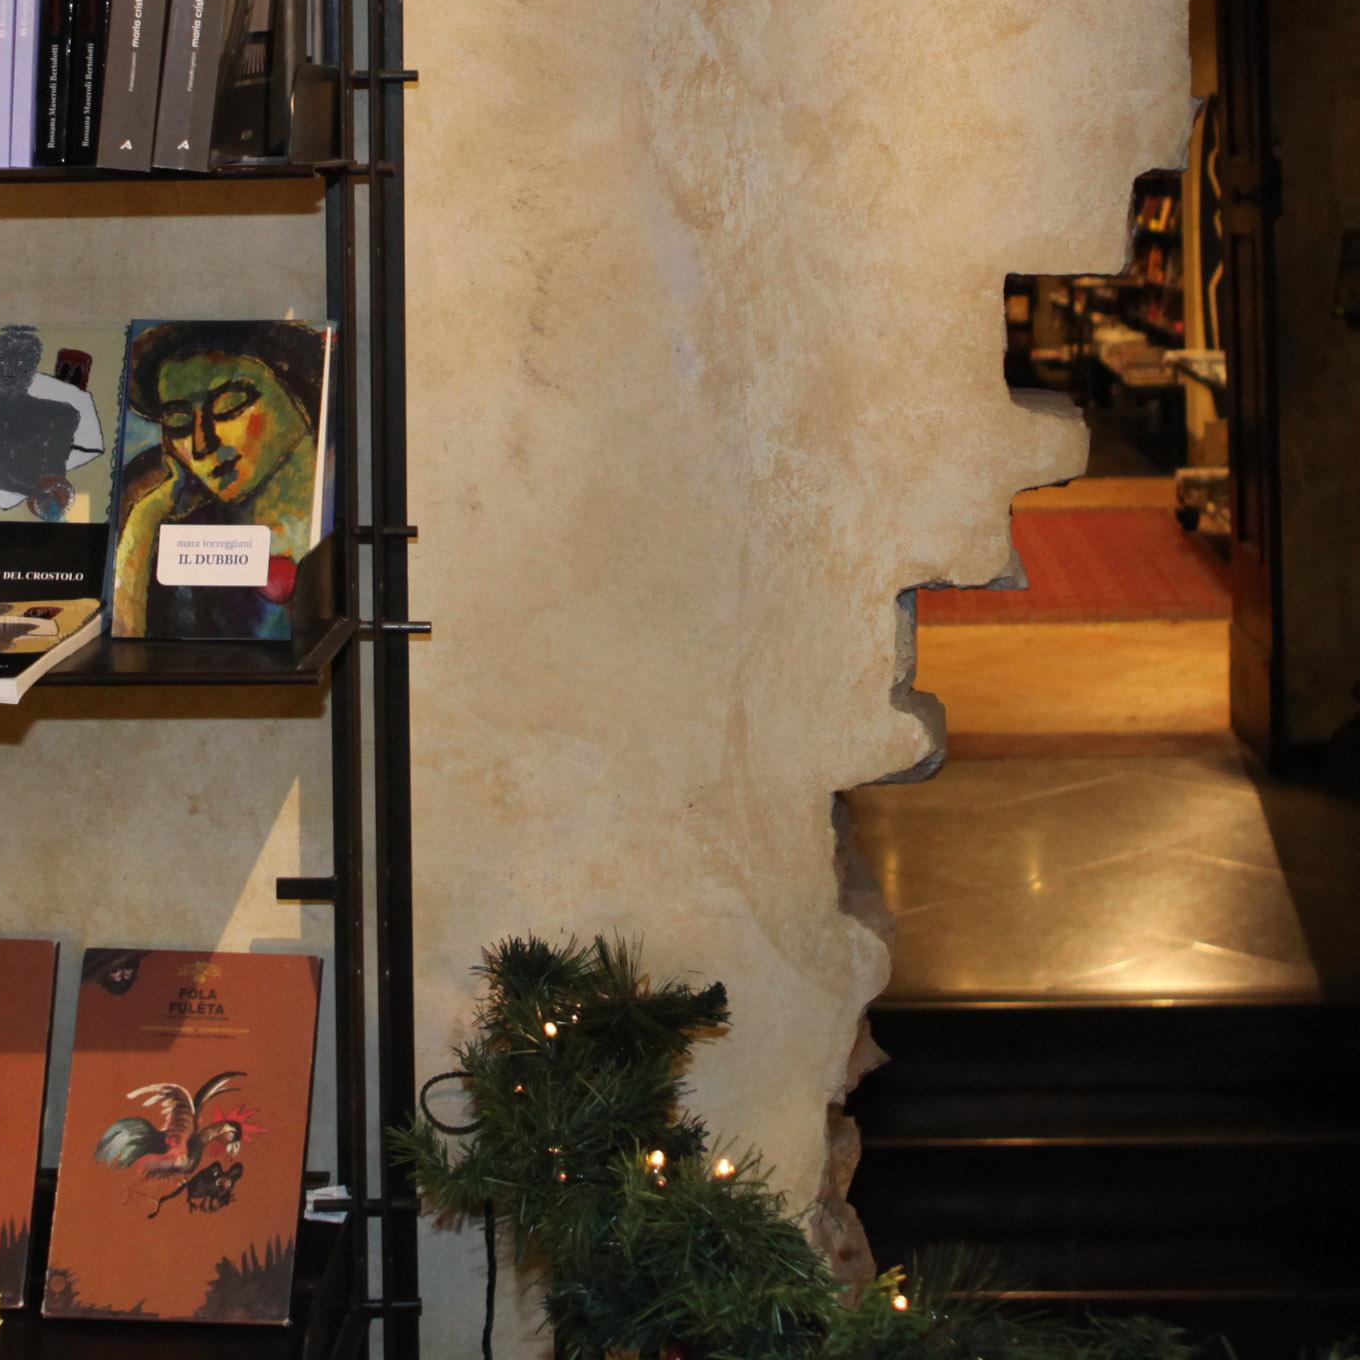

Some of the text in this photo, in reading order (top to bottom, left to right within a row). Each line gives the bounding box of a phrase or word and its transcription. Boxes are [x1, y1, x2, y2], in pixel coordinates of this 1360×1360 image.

[131, 20, 141, 47] maria
[191, 20, 201, 47] maria
[48, 44, 59, 148] Rossana Maseroli Bertolotti
[82, 43, 94, 147] Rossana Maseroli Bertolotti
[177, 538, 253, 550] mara torreggiani
[178, 554, 249, 565] IL DUBBIO
[3, 571, 24, 580] DEL
[25, 571, 84, 581] CROSTOLO
